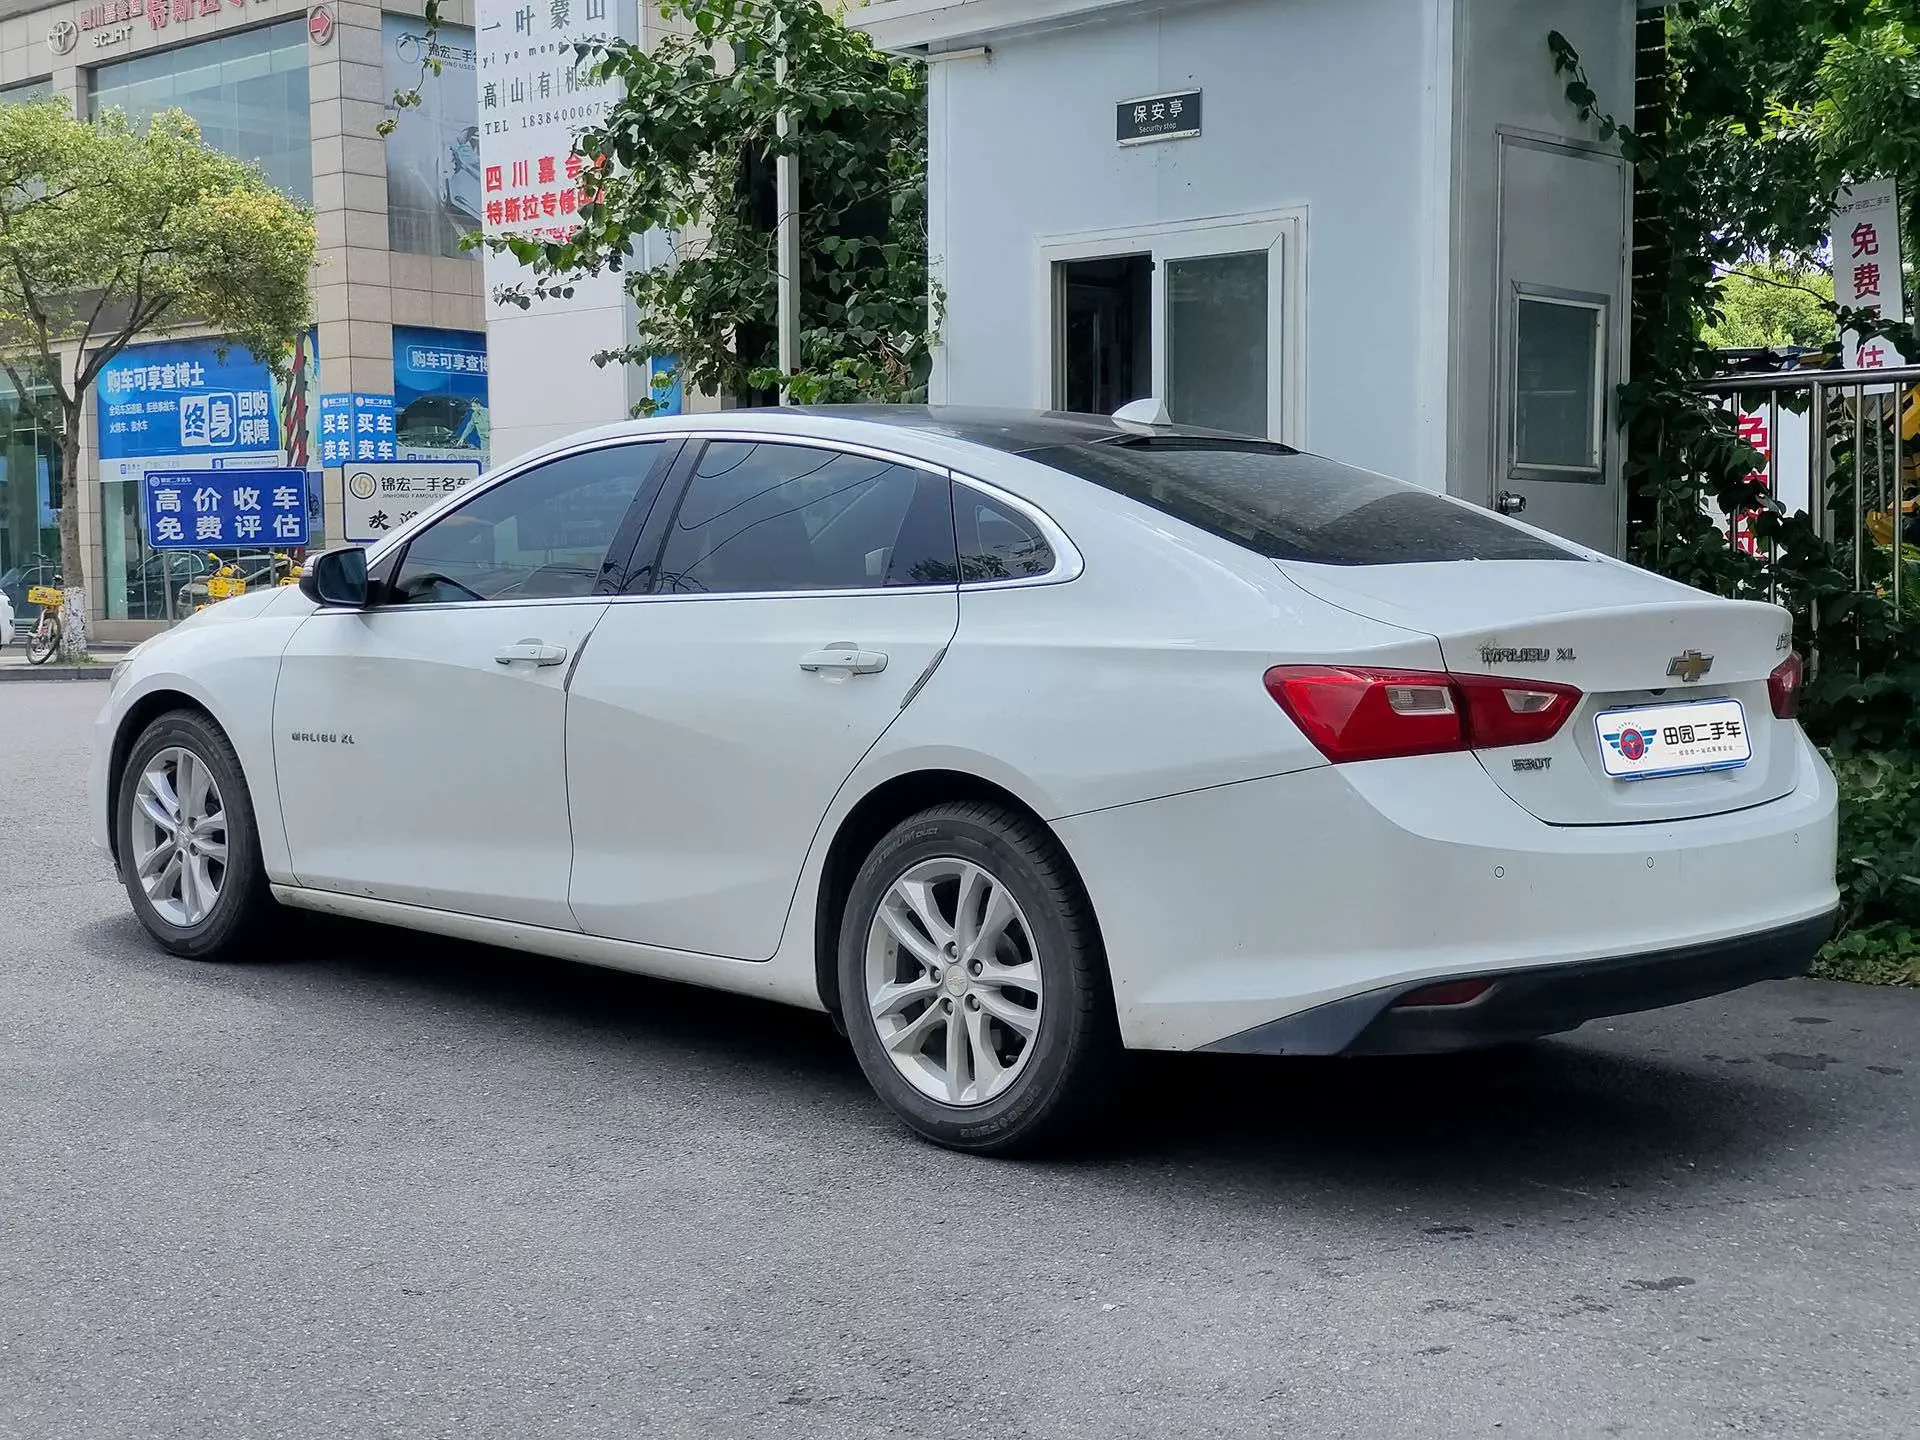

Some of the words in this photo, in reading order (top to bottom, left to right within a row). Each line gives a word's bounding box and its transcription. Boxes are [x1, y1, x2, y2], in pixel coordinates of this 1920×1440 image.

[147, 0, 244, 30] 特斯拉
[529, 42, 570, 58] men
[1133, 98, 1184, 124] 保安亭
[485, 120, 509, 135] TEL
[1139, 124, 1163, 134] Security
[1163, 122, 1177, 132] stop
[485, 153, 607, 193] 四川嘉会
[486, 185, 607, 226] 特斯拉专修
[1850, 222, 1885, 369] 免费估
[107, 361, 205, 393] 购车可享查博士
[183, 401, 233, 439] 终身
[323, 412, 349, 434] 买车
[357, 413, 393, 434] 买车
[323, 439, 351, 461] 卖车
[358, 439, 394, 460] 卖车
[154, 486, 300, 513] 高价收车
[155, 515, 301, 541] 免费评估
[1556, 647, 1577, 661] XL
